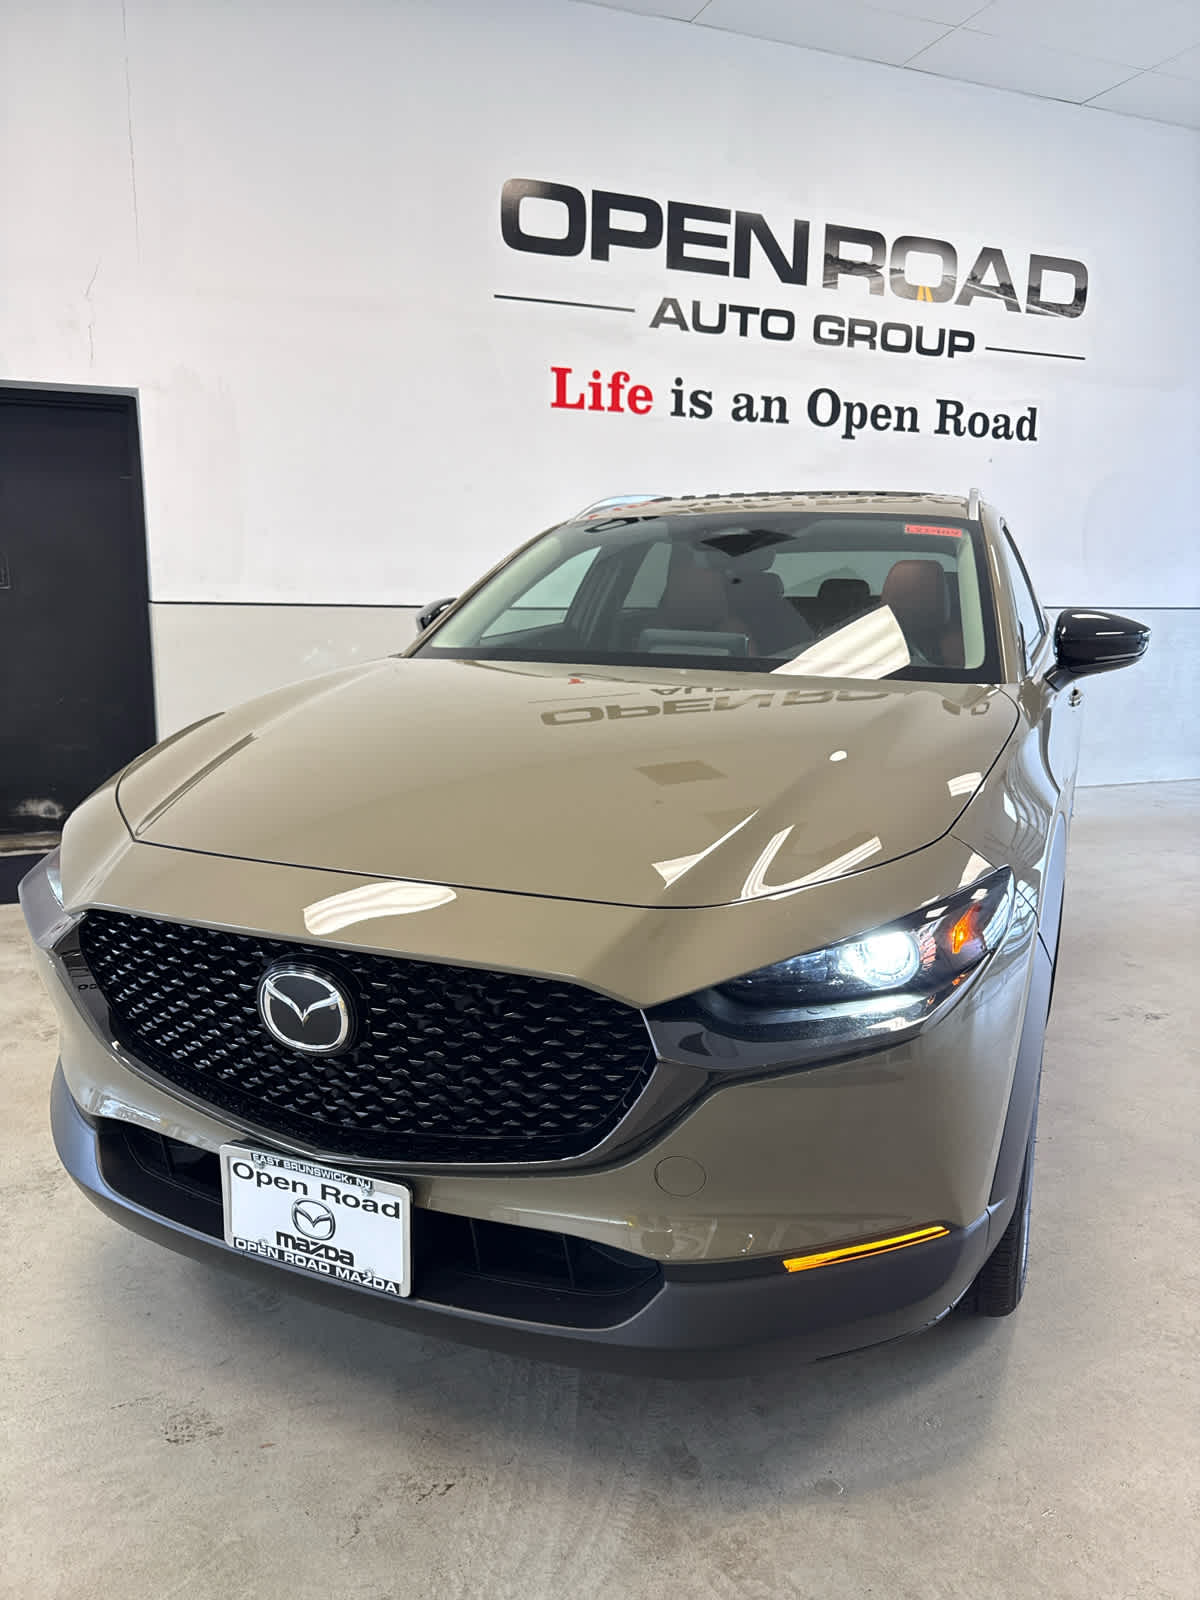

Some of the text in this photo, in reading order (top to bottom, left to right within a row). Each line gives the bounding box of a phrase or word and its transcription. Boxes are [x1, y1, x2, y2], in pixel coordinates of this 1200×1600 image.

[501, 178, 1089, 320] OPEN ROAD
[649, 297, 976, 359] AUTO GROUP
[550, 366, 1038, 442] Life is an Open Road
[232, 1162, 400, 1219] Open Road
[252, 1153, 279, 1167] EAST
[356, 1178, 373, 1190] NJ
[235, 1238, 398, 1294] OPEN ROAD MAZDA
